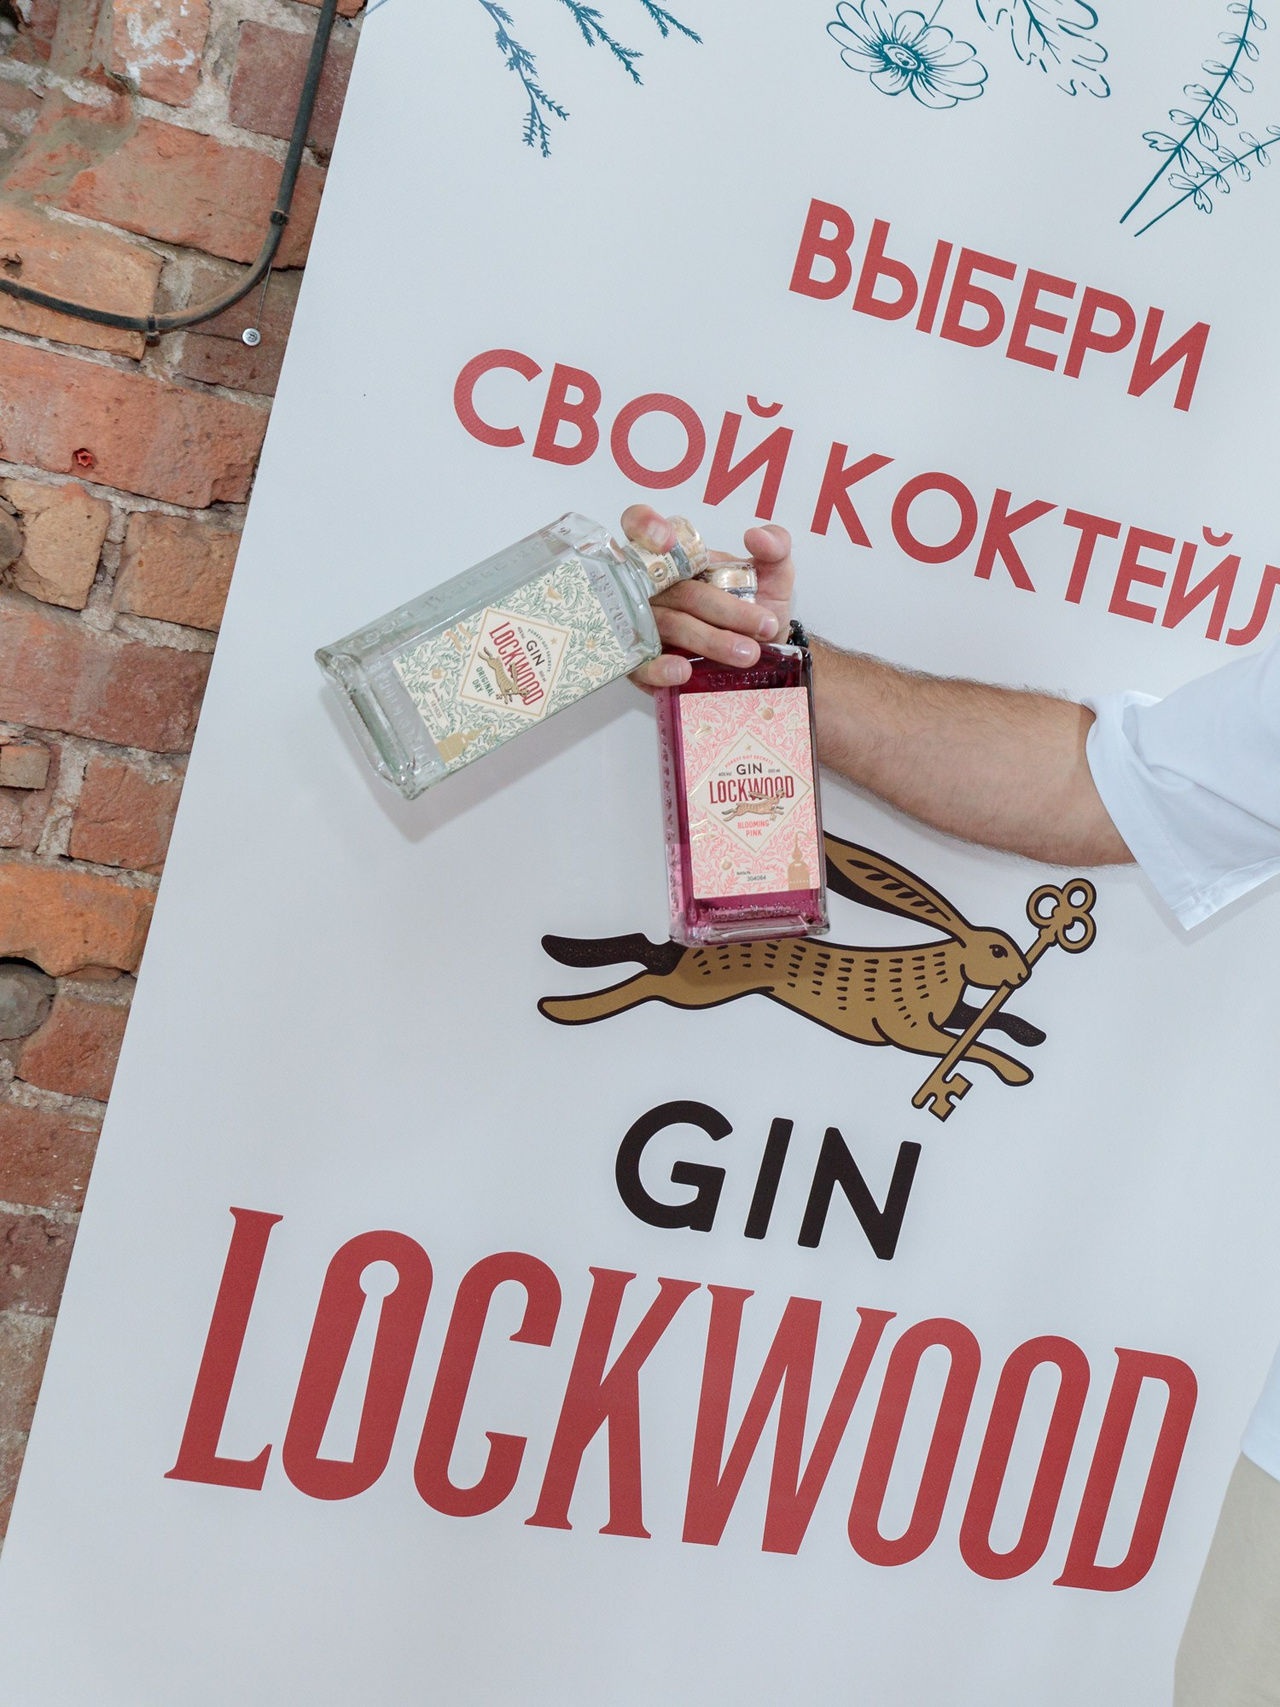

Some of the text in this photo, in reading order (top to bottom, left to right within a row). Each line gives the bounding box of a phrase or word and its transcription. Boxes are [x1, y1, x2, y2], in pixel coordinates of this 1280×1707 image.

[790, 199, 1211, 412] ВЫБЕРИ
[454, 350, 793, 520] СВОЙ
[489, 621, 544, 705] LOCKWOOD
[526, 640, 545, 666] GIN
[472, 679, 483, 692] DRY
[476, 666, 495, 697] ORIGINAL
[736, 763, 762, 775] GIN
[709, 775, 795, 804] LOCKWOOD
[737, 821, 770, 829] BLOOMING
[745, 829, 762, 837] PINK
[616, 1101, 922, 1261] GIN
[165, 1207, 1198, 1592] LOCKWOOD
